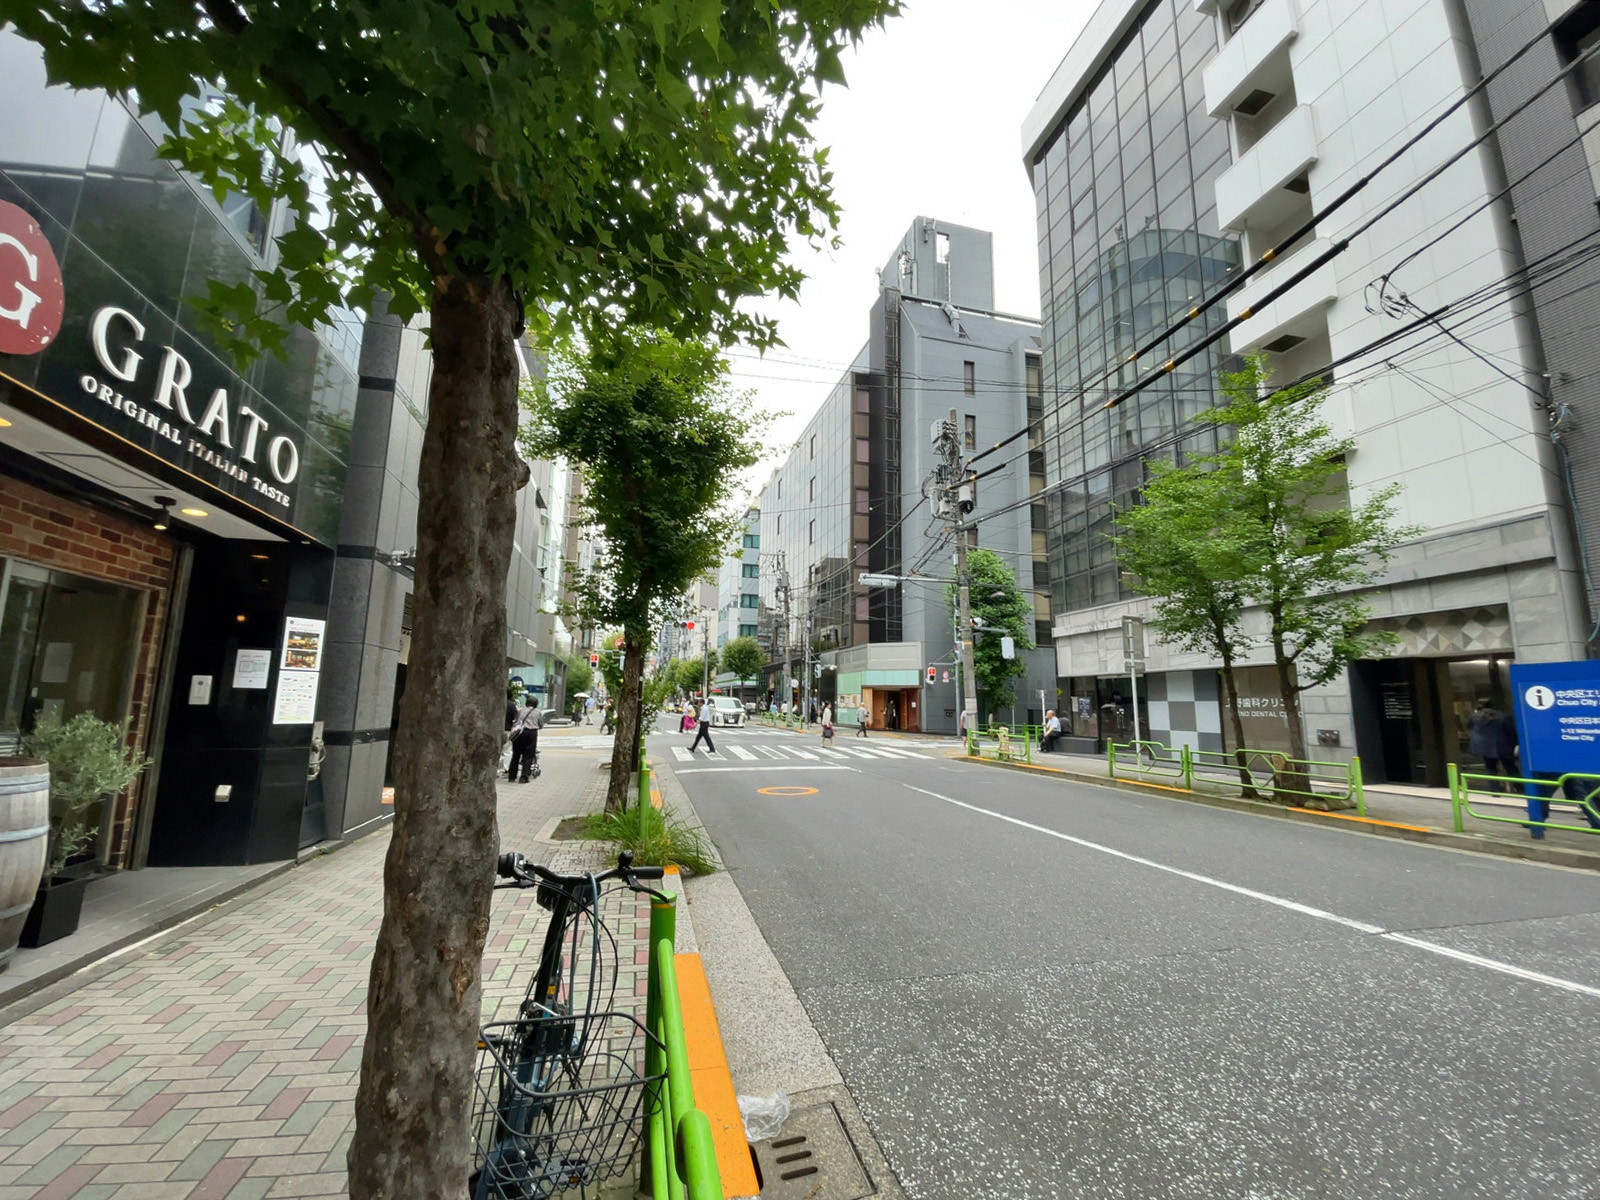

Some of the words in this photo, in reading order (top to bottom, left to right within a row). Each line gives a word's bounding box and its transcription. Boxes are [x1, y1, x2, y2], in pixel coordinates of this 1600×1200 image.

[79, 375, 183, 445] ORIGINAL
[187, 438, 249, 483] ITALIAN
[252, 476, 291, 508] TASTE
[90, 306, 299, 484] GRATO
[1580, 698, 1598, 707] City
